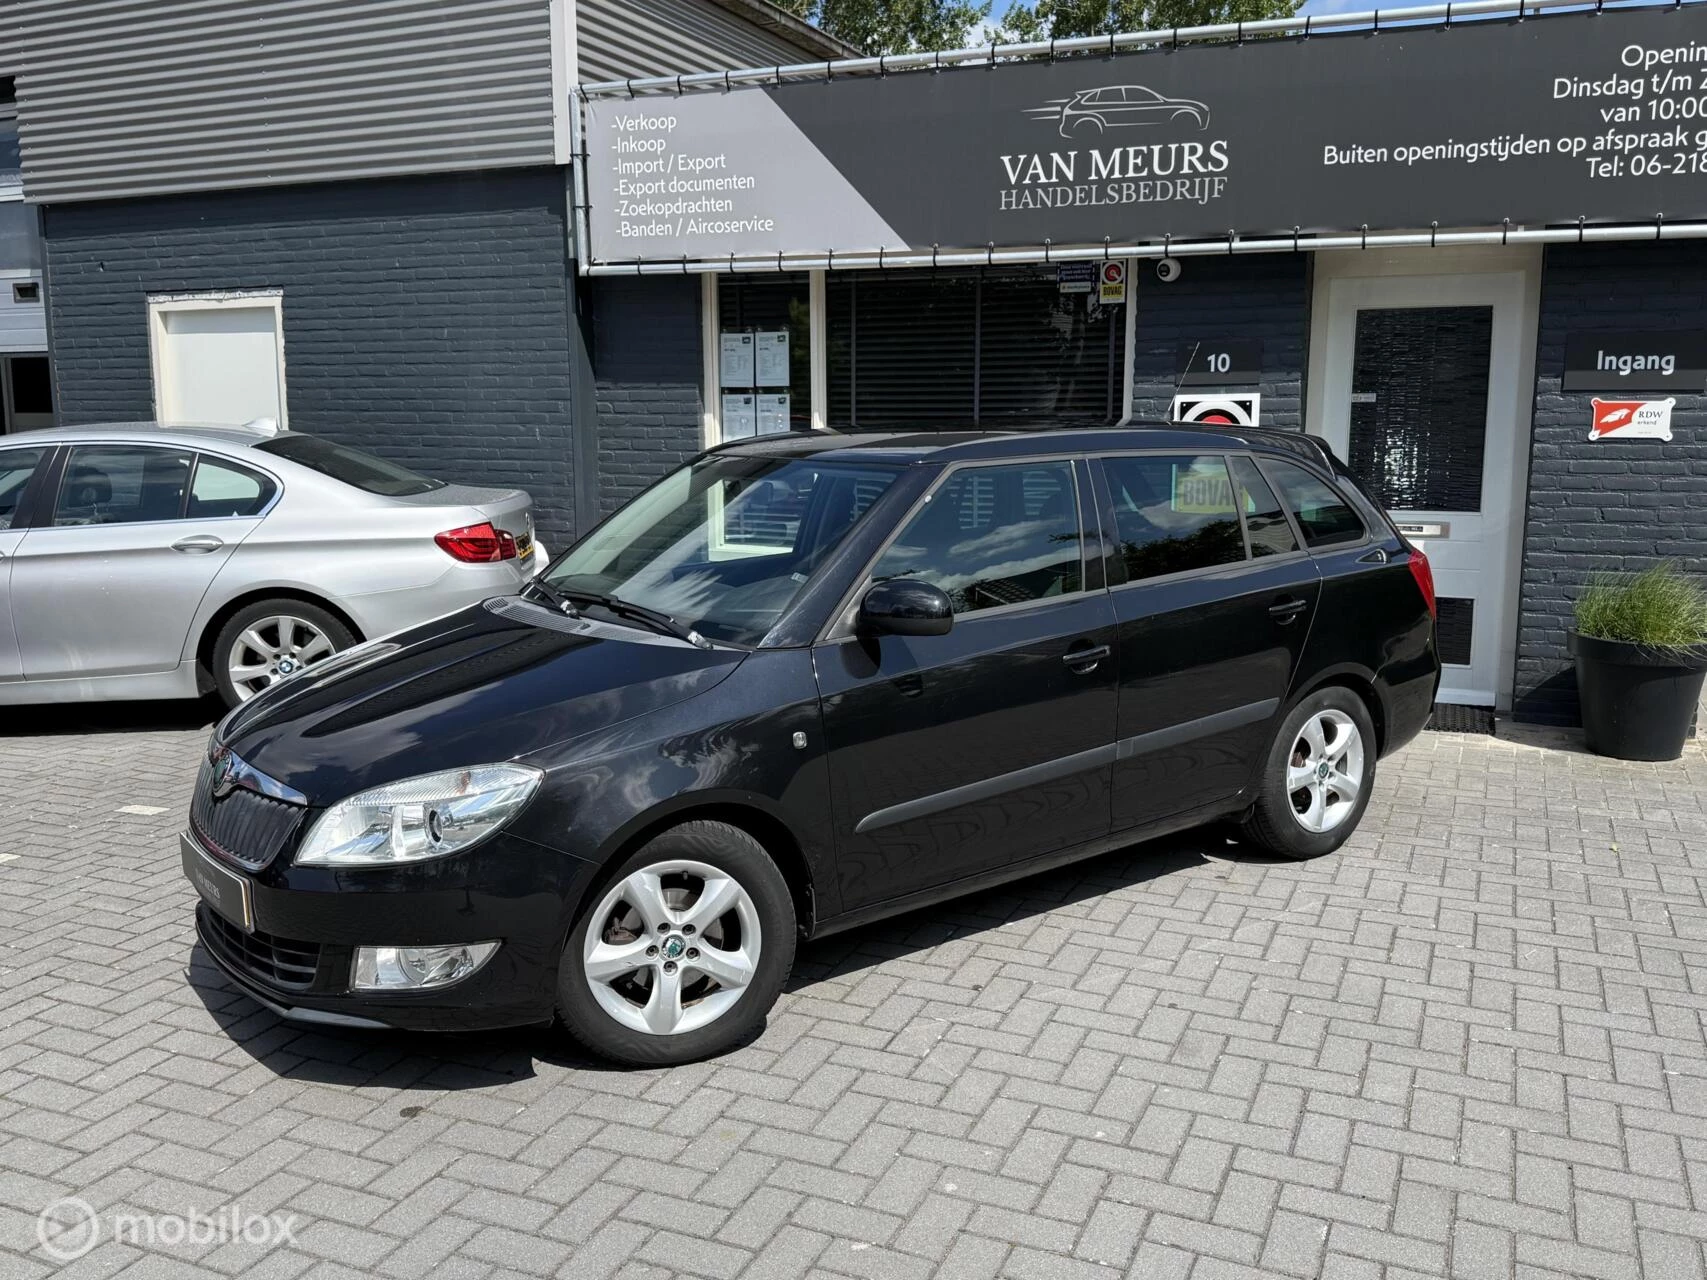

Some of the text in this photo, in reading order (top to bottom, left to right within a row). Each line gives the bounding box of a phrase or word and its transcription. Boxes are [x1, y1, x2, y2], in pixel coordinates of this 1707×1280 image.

[1621, 40, 1707, 71] Openin
[1553, 73, 1645, 99] Dinsdag
[1651, 68, 1692, 95] t/m
[611, 113, 677, 133] -Verkoop
[1600, 103, 1641, 122] van
[611, 135, 667, 155] -Inkoop
[1324, 143, 1388, 165] Buiten
[1393, 133, 1550, 167] openingstijden
[1556, 136, 1587, 157] op
[1592, 124, 1689, 155] afspraak
[612, 157, 665, 178] -Import
[678, 153, 726, 175] Export
[1000, 139, 1230, 185] VAN MEURS
[1586, 156, 1625, 178] Tel:
[613, 174, 755, 200] -Export documenten
[999, 176, 1228, 211] HANDELSBEDRIJF
[615, 219, 673, 238] -Banden
[686, 215, 774, 235] Aircoservice
[1207, 353, 1231, 373] 10
[1597, 350, 1676, 376] Ingang
[1638, 410, 1664, 419] RDW
[1183, 479, 1242, 506] BOVA
